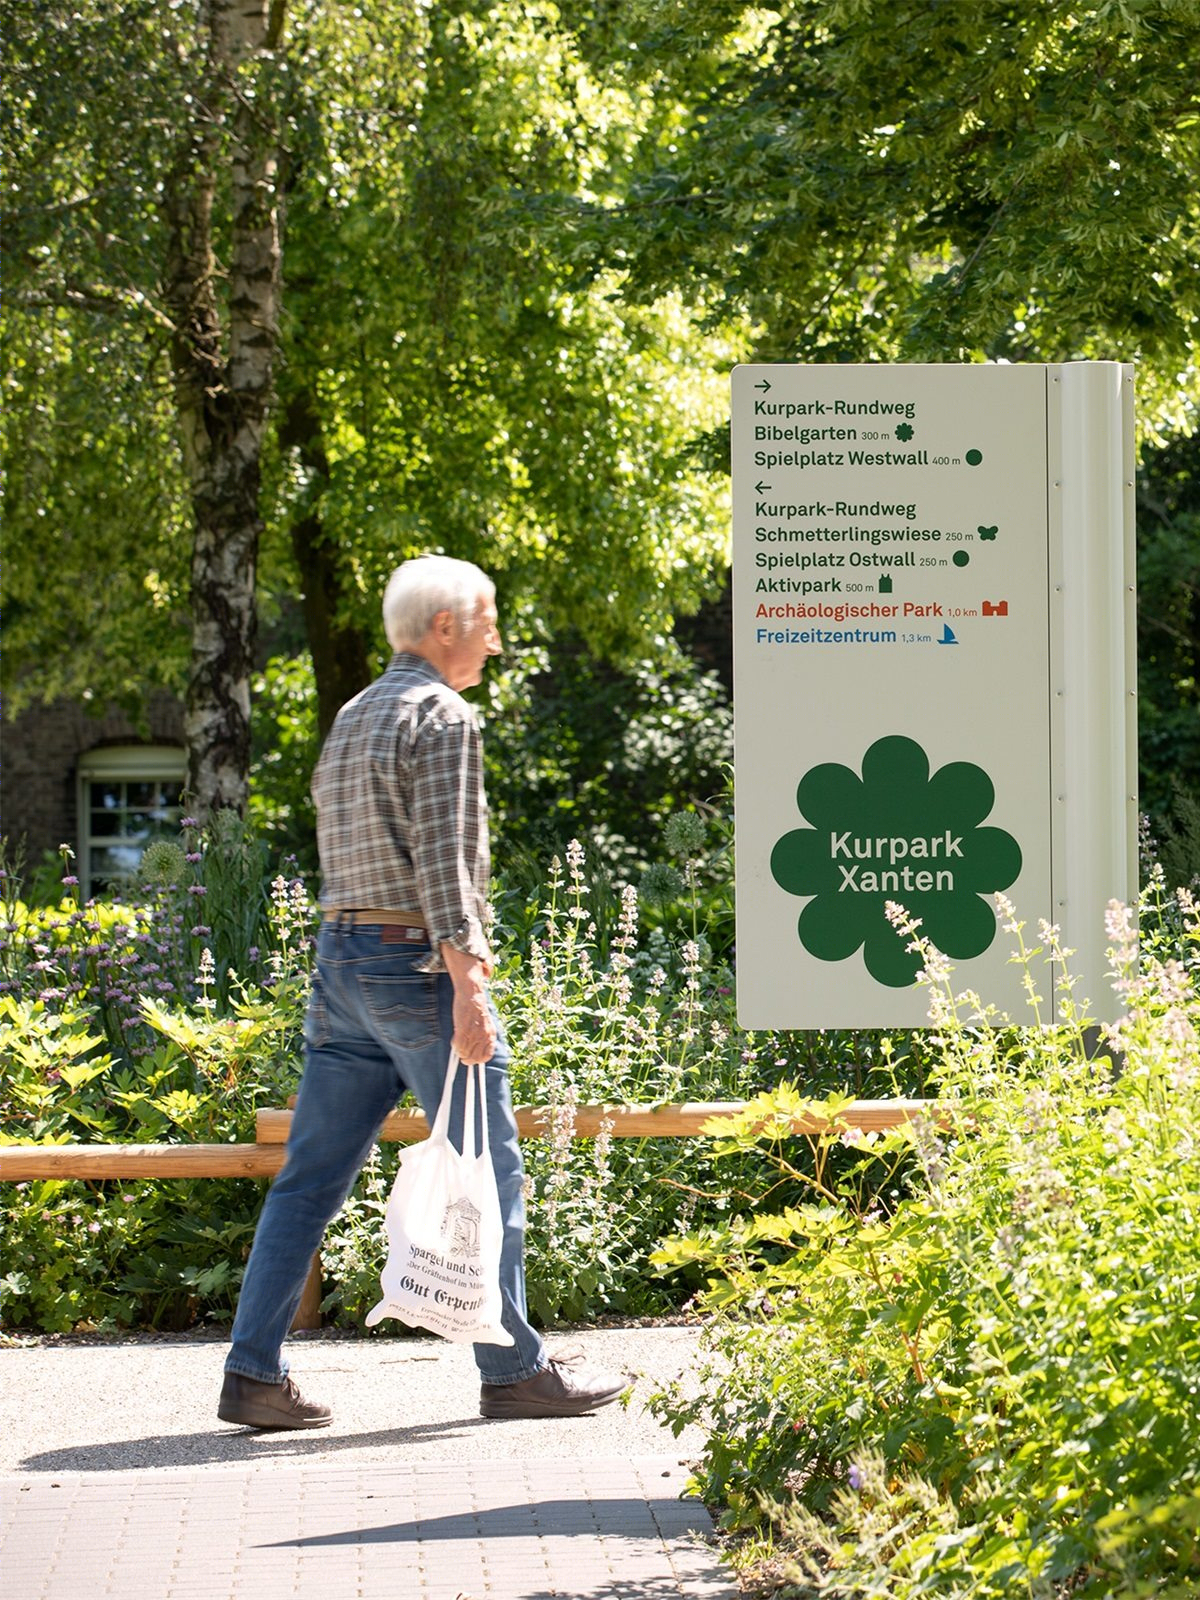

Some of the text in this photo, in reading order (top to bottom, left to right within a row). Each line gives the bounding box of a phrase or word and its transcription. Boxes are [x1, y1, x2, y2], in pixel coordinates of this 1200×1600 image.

[755, 400, 915, 419] Kurpark-Rundweg
[755, 426, 890, 445] Bibelgarten 300 m
[755, 451, 844, 469] Spielplatz
[848, 450, 928, 465] Westwall
[931, 456, 950, 466] 400
[756, 501, 916, 520] Kurpark-Rundweg
[755, 526, 974, 545] Schmetterlingswiese 250 m
[756, 552, 948, 571] Spielplatz Ostwall 250 m
[755, 577, 841, 596] Aktivpark
[845, 583, 864, 593] 500
[756, 602, 978, 622] Archäologischer Park 1,0 km
[756, 628, 932, 644] Freizeitzentrum 1,3 km
[831, 831, 964, 864] Kurpark
[838, 865, 954, 892] Xanten
[408, 1243, 445, 1267] Spargel
[446, 1260, 466, 1275] und
[400, 1275, 430, 1298] Gut
[421, 1266, 458, 1284] Gräftenhof
[458, 1280, 467, 1289] im
